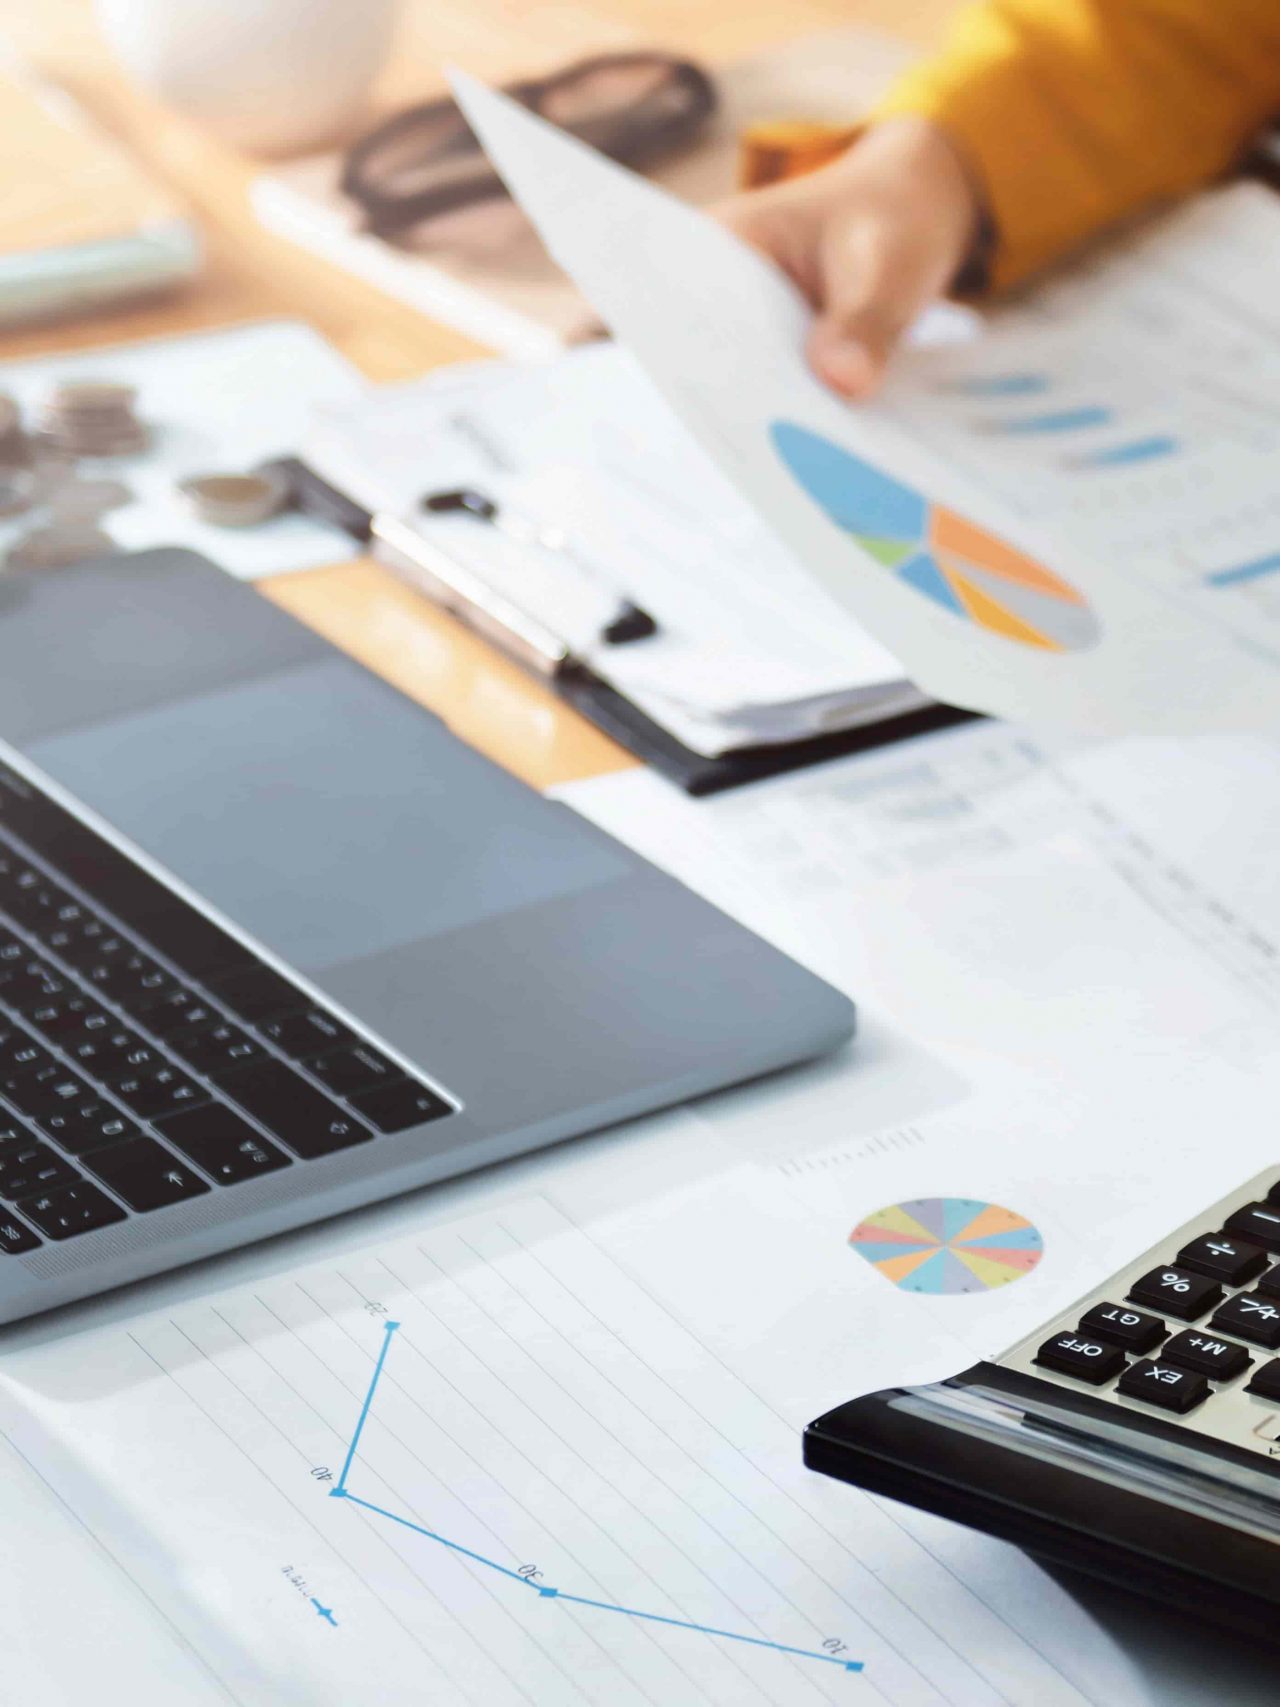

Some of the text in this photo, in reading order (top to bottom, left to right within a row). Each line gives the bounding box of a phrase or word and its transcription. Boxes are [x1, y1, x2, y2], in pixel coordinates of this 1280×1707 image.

[1102, 1310, 1140, 1326] GT
[1057, 1338, 1103, 1357] OFF
[1188, 1338, 1227, 1356] M+
[1145, 1366, 1184, 1385] EX
[311, 1466, 333, 1481] 40
[518, 1563, 544, 1583] 30
